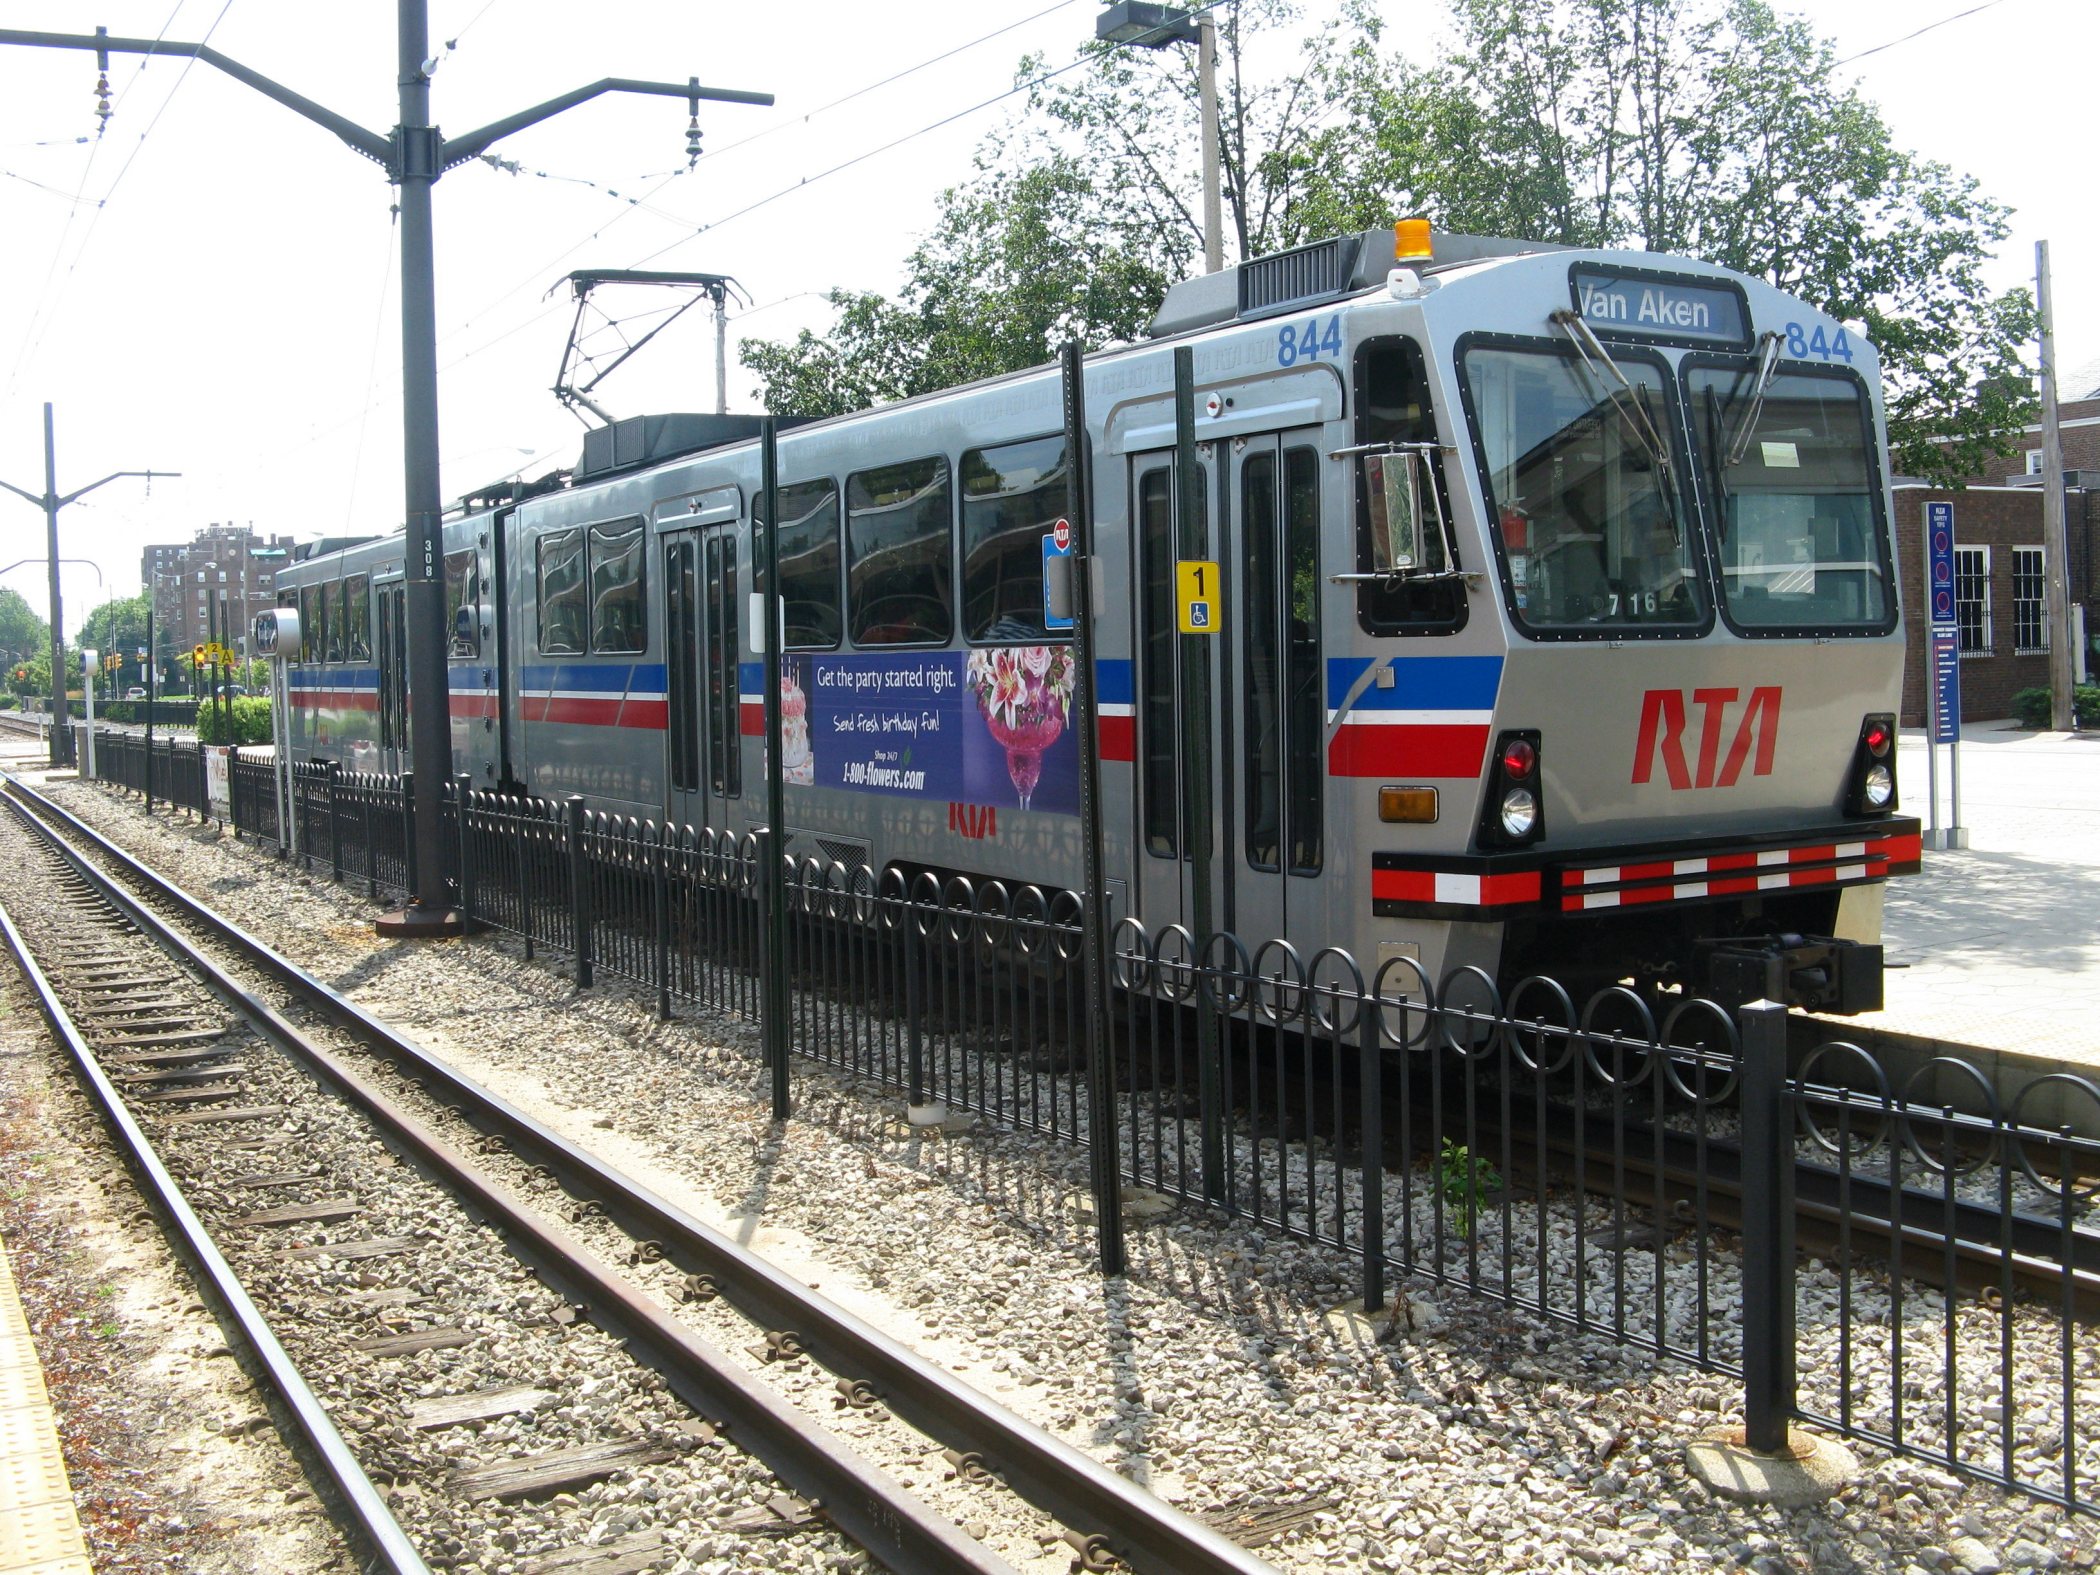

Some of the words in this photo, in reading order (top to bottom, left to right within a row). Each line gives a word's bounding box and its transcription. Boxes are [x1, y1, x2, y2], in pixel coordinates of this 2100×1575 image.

[1579, 283, 1627, 320] Van
[1637, 289, 1709, 328] Aken
[1278, 314, 1342, 367] 844
[1785, 322, 1853, 363] 844
[1055, 529, 1069, 541] RTA
[424, 539, 433, 577] 308
[1192, 566, 1205, 597] 1
[212, 644, 218, 652] 2
[222, 650, 232, 663] A
[817, 666, 835, 687] Get
[837, 665, 854, 687] the
[855, 670, 882, 693] party
[885, 664, 923, 687] started
[926, 664, 957, 694] right.
[833, 713, 855, 732] Send
[857, 713, 880, 733] fresh
[882, 712, 918, 739] birthday
[921, 709, 940, 731] fun!
[1631, 686, 1782, 790] RTA
[874, 749, 886, 762] Shop
[887, 751, 898, 762] 24/7
[843, 761, 925, 790] 1-800-flowers.com
